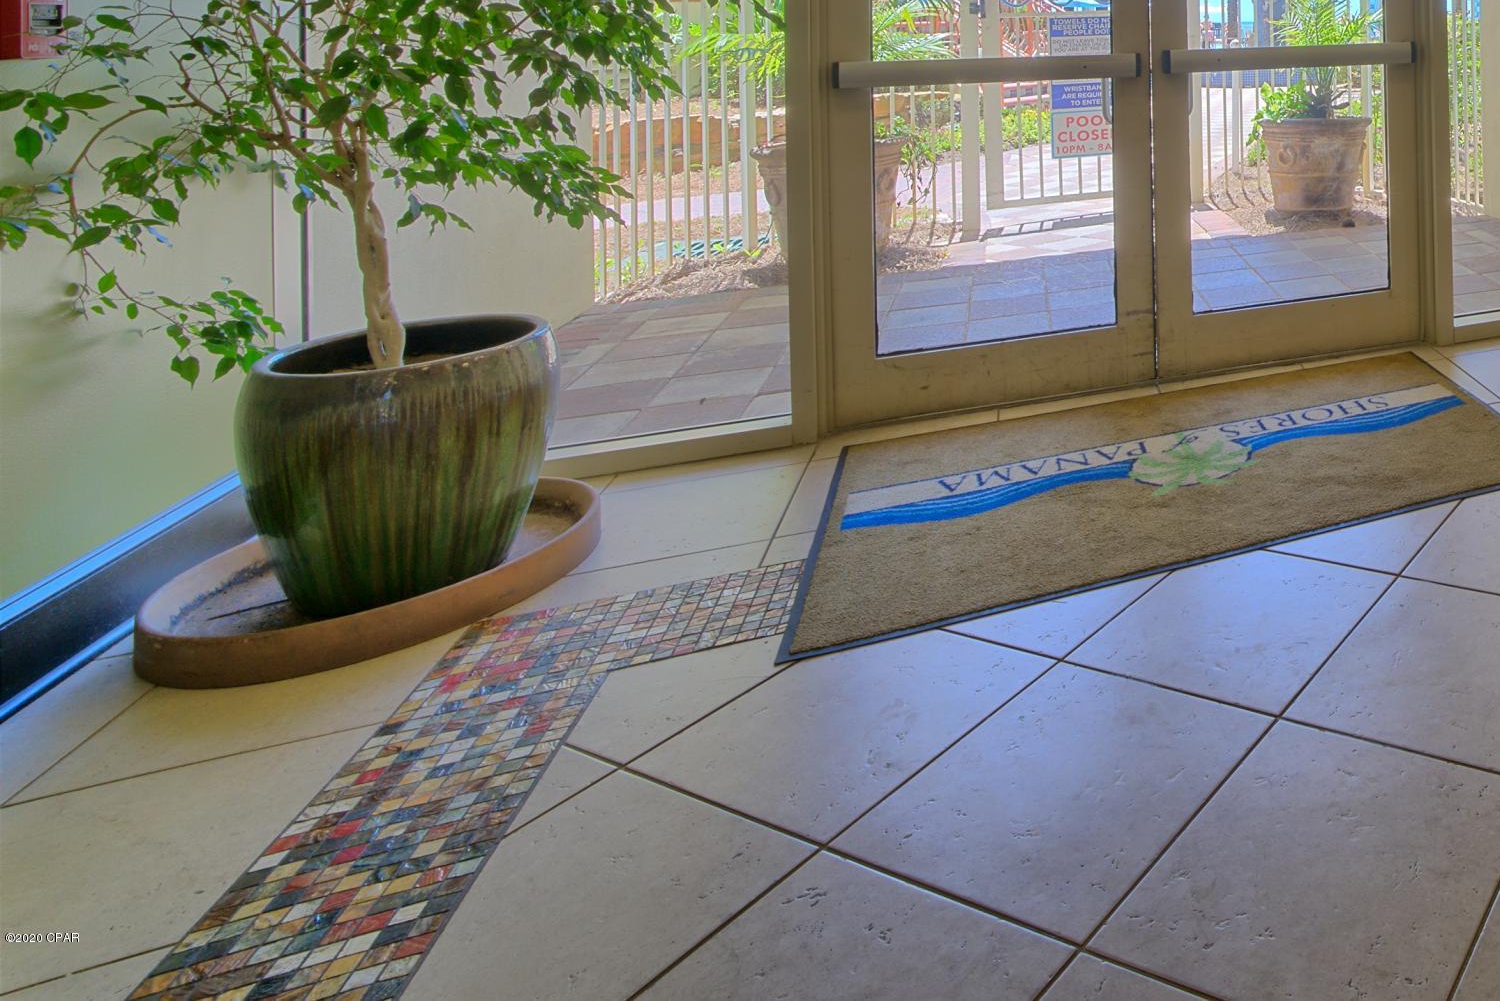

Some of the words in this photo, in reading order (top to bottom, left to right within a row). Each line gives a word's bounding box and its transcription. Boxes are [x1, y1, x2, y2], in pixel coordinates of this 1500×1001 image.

[1066, 116, 1103, 128] POO
[1057, 129, 1109, 143] CLOSE
[1056, 145, 1086, 154] 10PM
[1097, 143, 1112, 152] 8A
[1219, 395, 1390, 440] SHORES
[937, 440, 1148, 494] PANAMA
